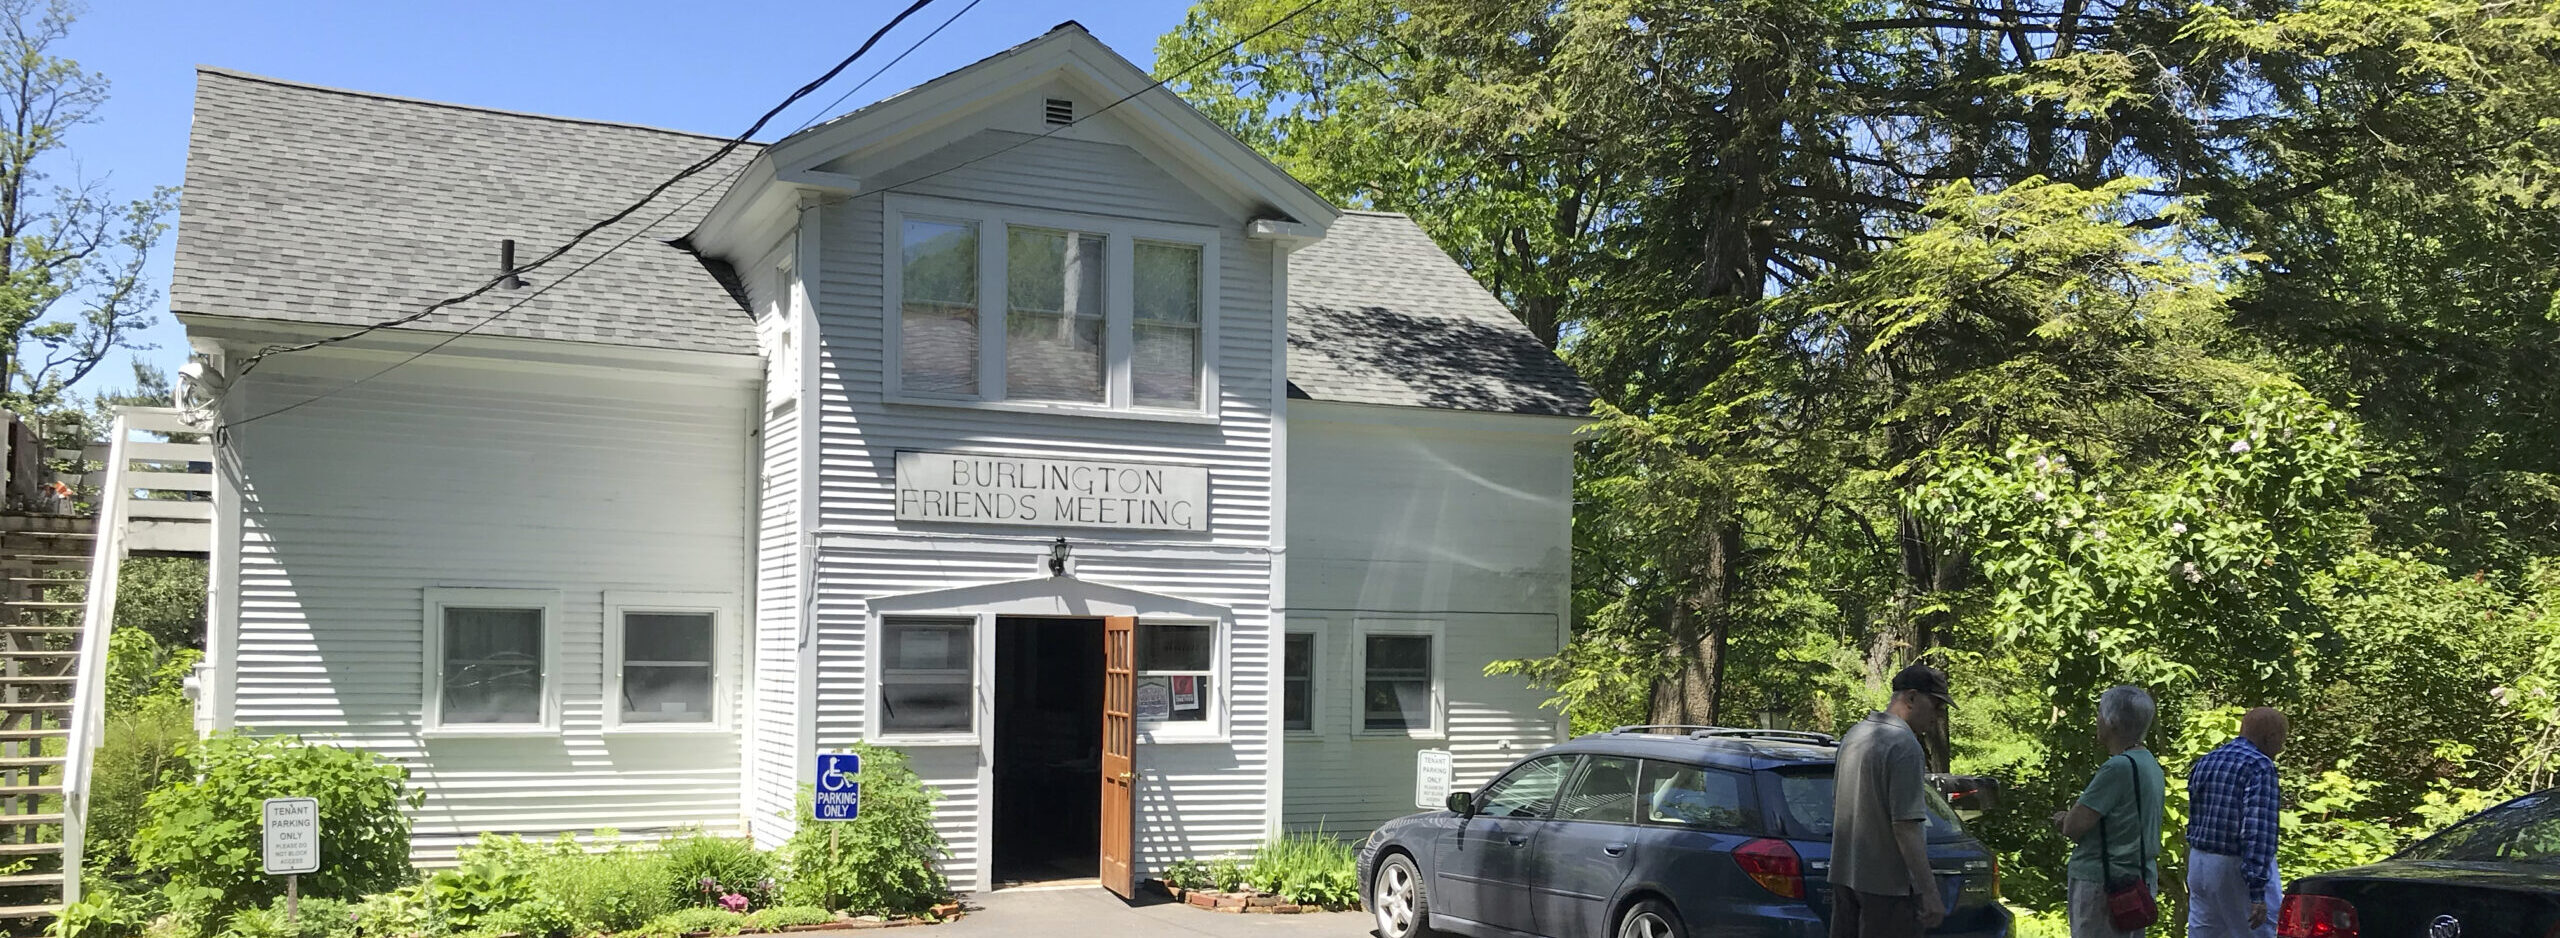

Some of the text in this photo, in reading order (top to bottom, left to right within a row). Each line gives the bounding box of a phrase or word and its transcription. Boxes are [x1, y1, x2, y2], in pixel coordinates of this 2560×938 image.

[952, 459, 1163, 495] BURLINGTON
[901, 489, 1192, 529] FRIENDS MEETING
[1423, 766, 1447, 774] PARKING
[817, 792, 857, 805] PARKING
[274, 806, 309, 816] TENANT
[823, 804, 849, 817] ONLY
[271, 819, 311, 828] PARKING
[280, 832, 303, 840] ONLY
